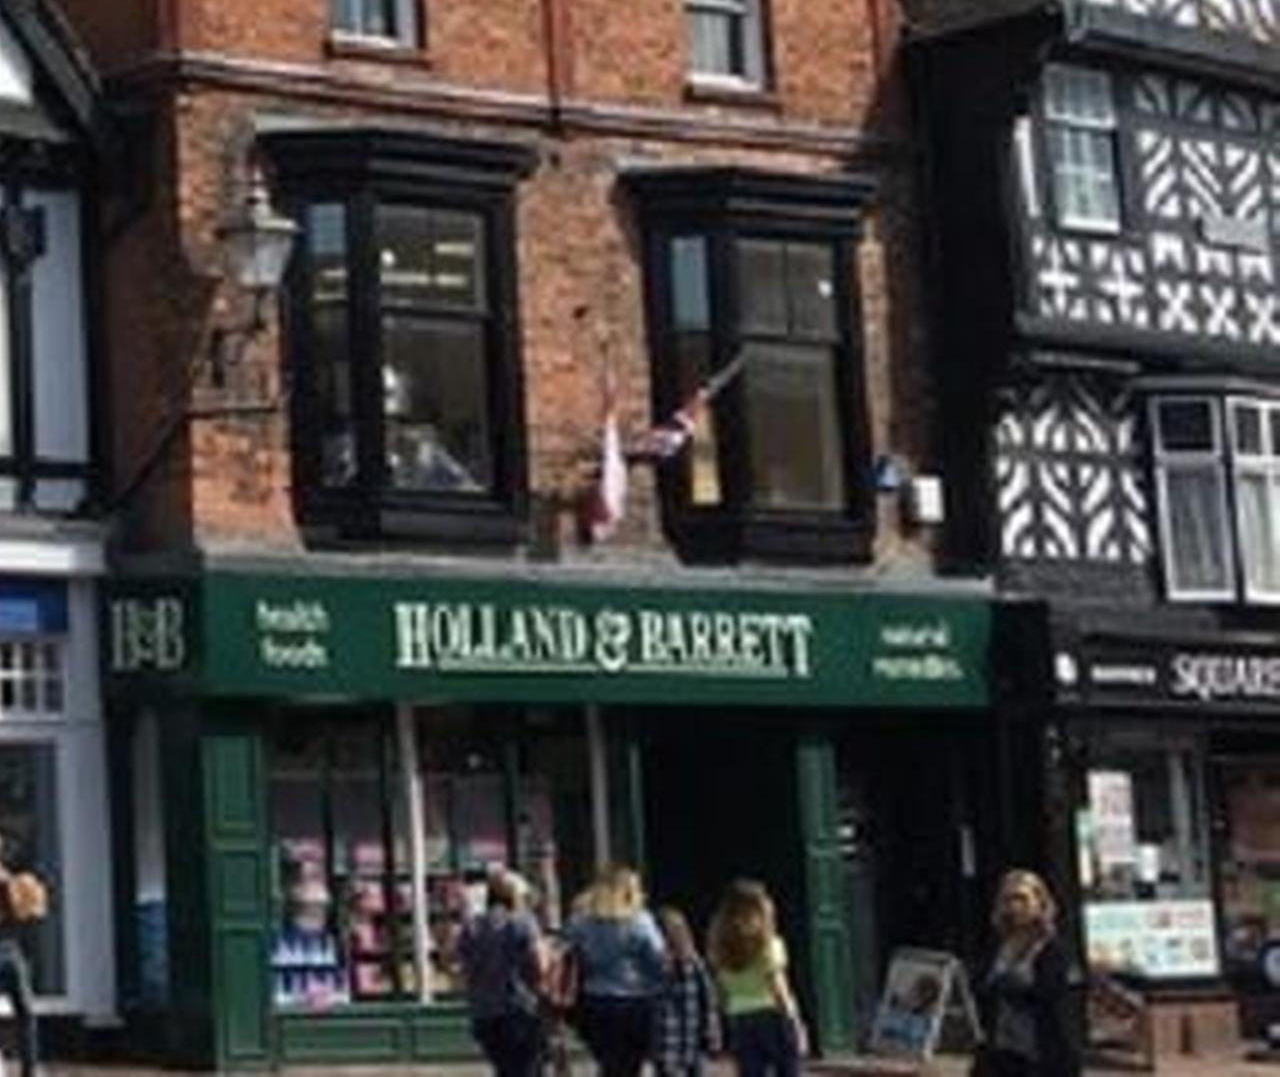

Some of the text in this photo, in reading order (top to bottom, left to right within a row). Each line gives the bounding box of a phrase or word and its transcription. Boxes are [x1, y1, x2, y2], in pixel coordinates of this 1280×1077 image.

[394, 603, 812, 677] HOLLAND & BARRETT
